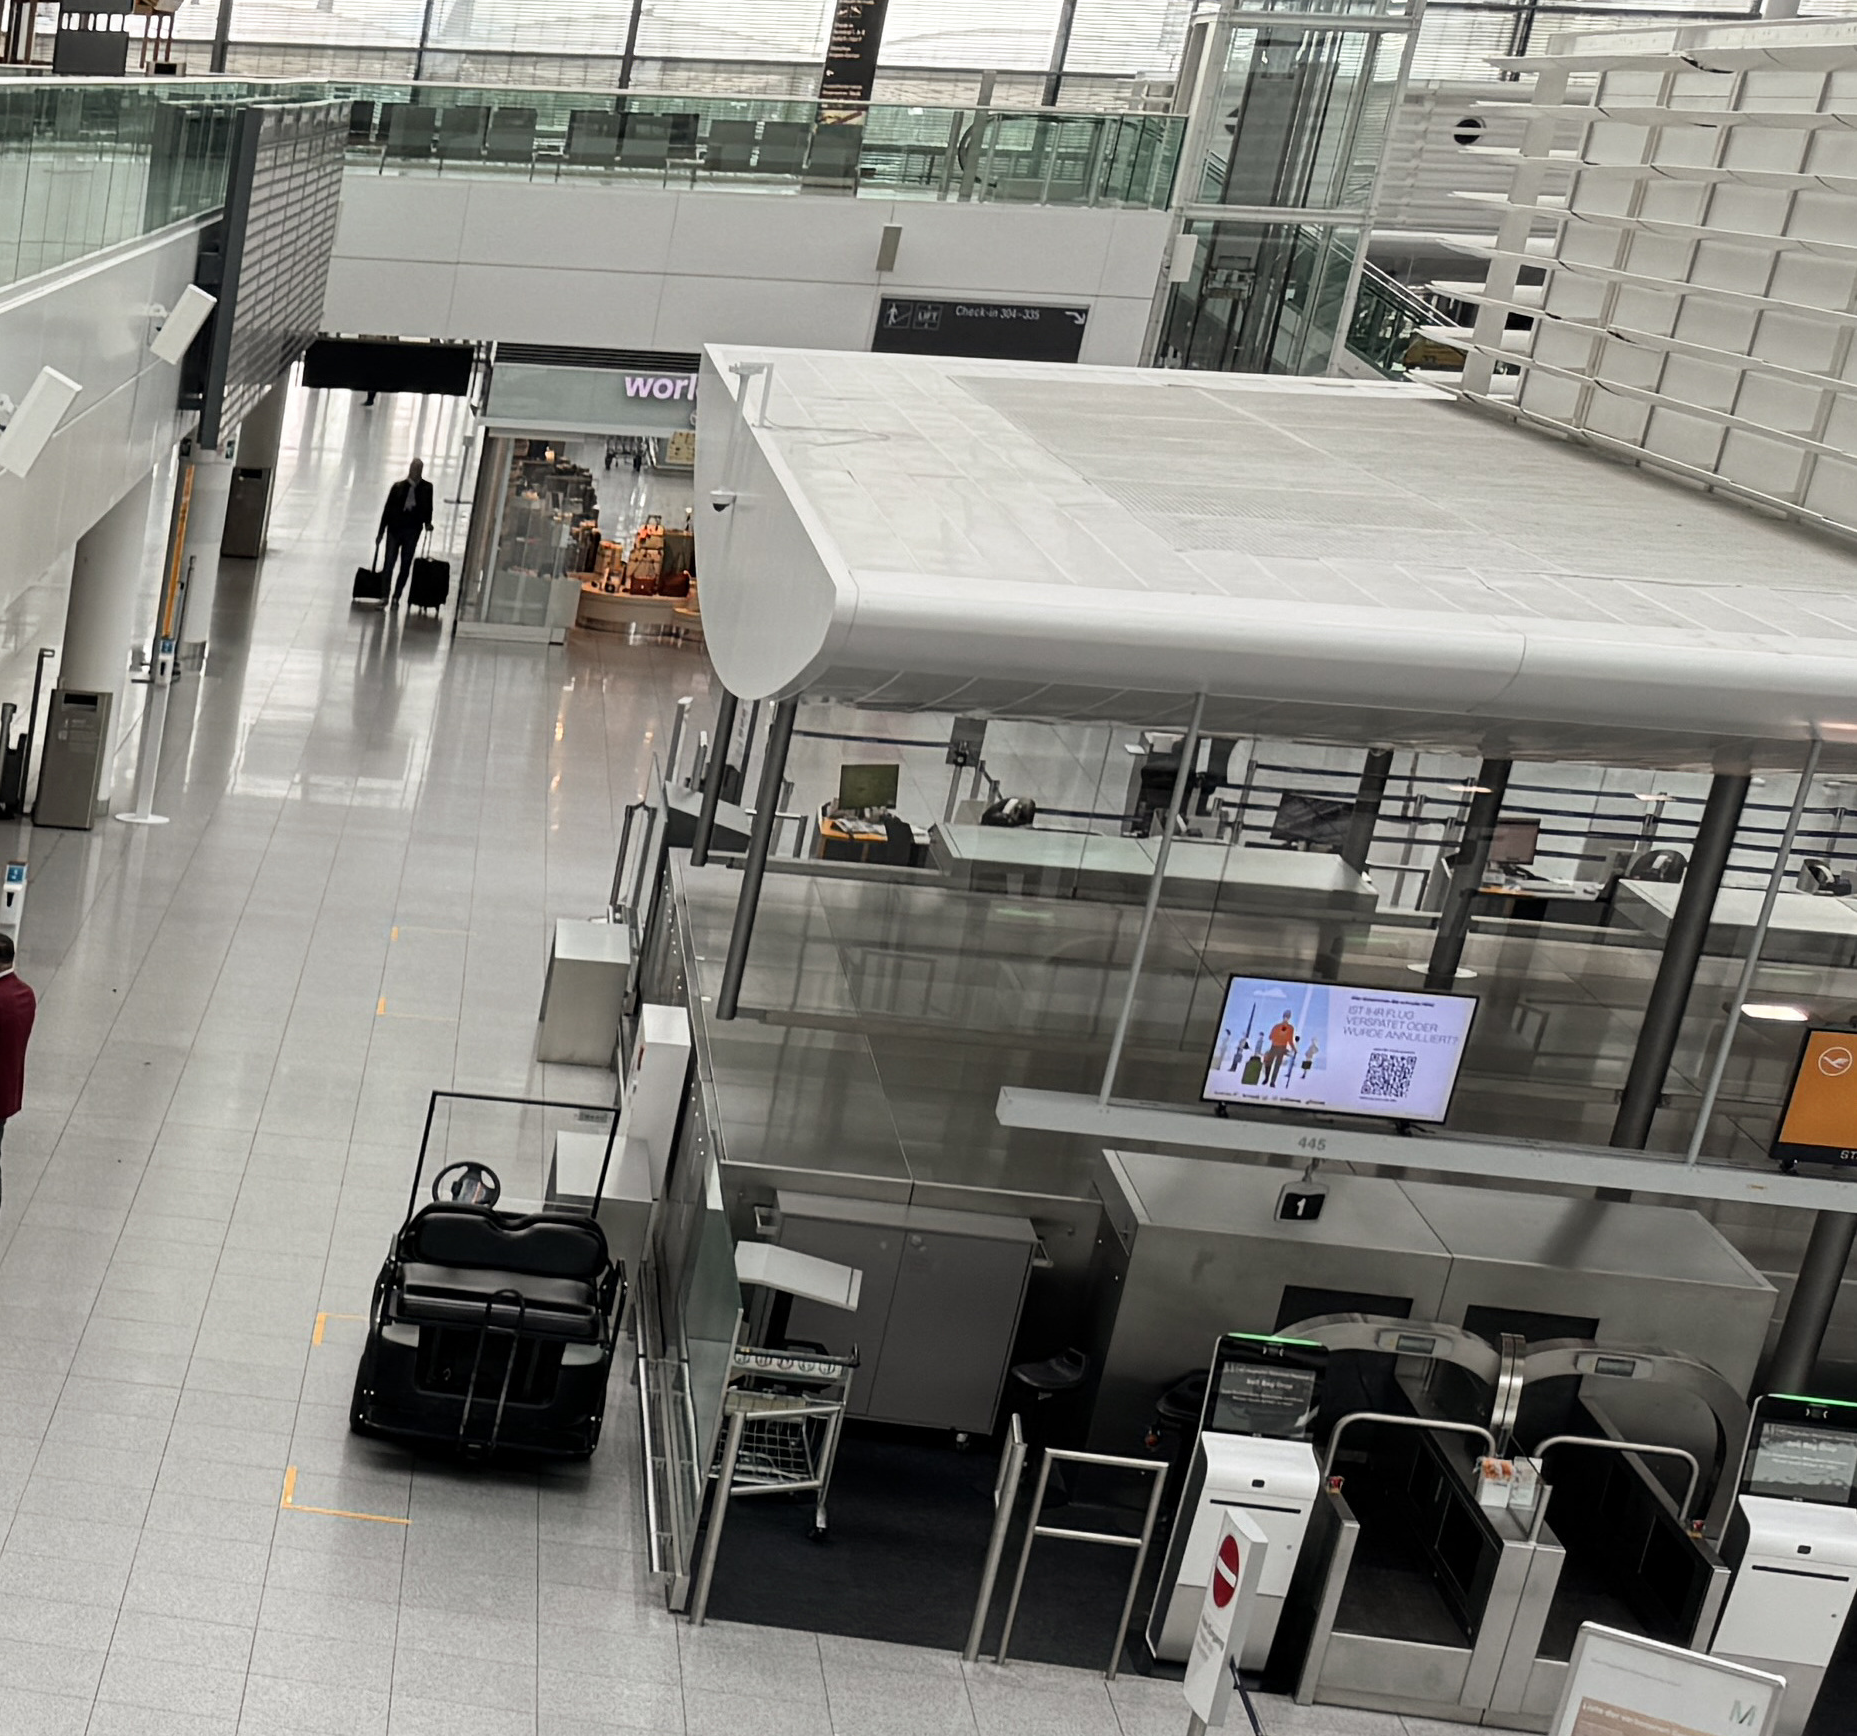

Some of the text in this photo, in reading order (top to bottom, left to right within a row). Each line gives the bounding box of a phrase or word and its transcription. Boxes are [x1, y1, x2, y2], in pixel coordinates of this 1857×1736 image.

[956, 305, 999, 319] Check-in
[624, 373, 698, 401] worl
[1297, 1135, 1327, 1152] 445
[1296, 1197, 1307, 1217] 1
